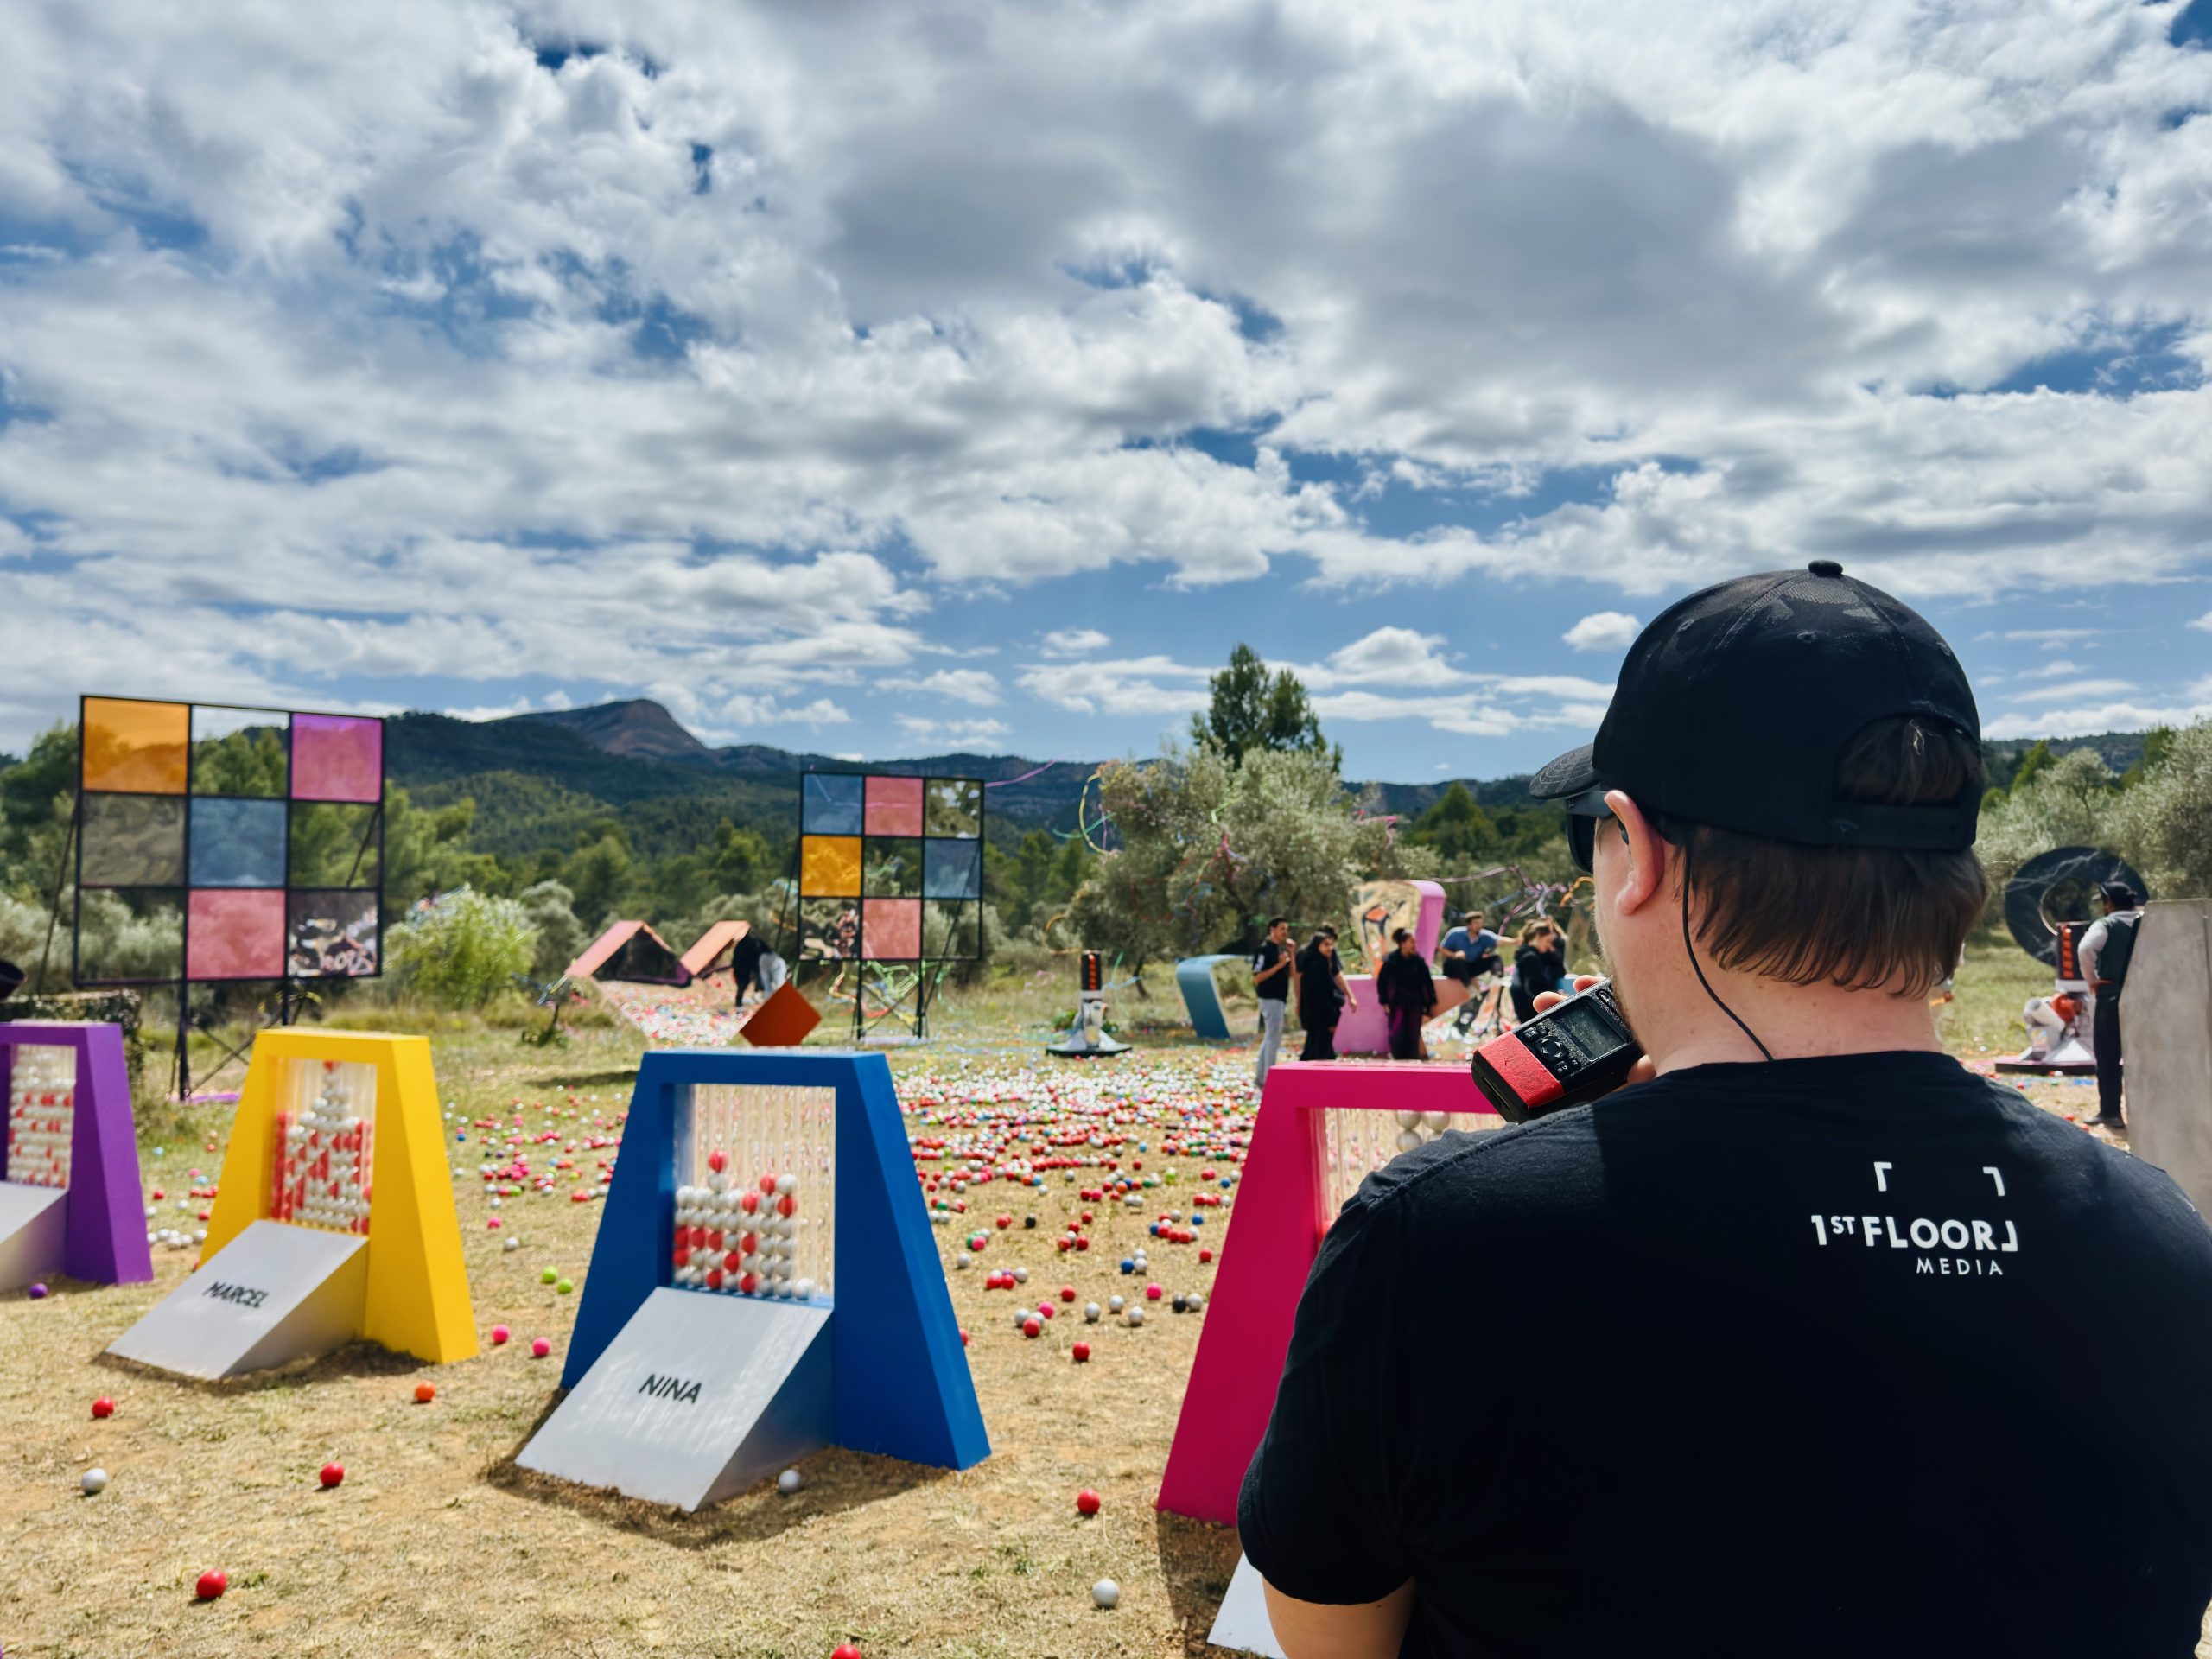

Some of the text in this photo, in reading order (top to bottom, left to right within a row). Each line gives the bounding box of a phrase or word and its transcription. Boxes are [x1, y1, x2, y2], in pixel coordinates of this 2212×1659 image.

[1916, 1257, 2004, 1276] MEDIA
[202, 1281, 270, 1308] MARCEL
[638, 1373, 702, 1404] NINA
